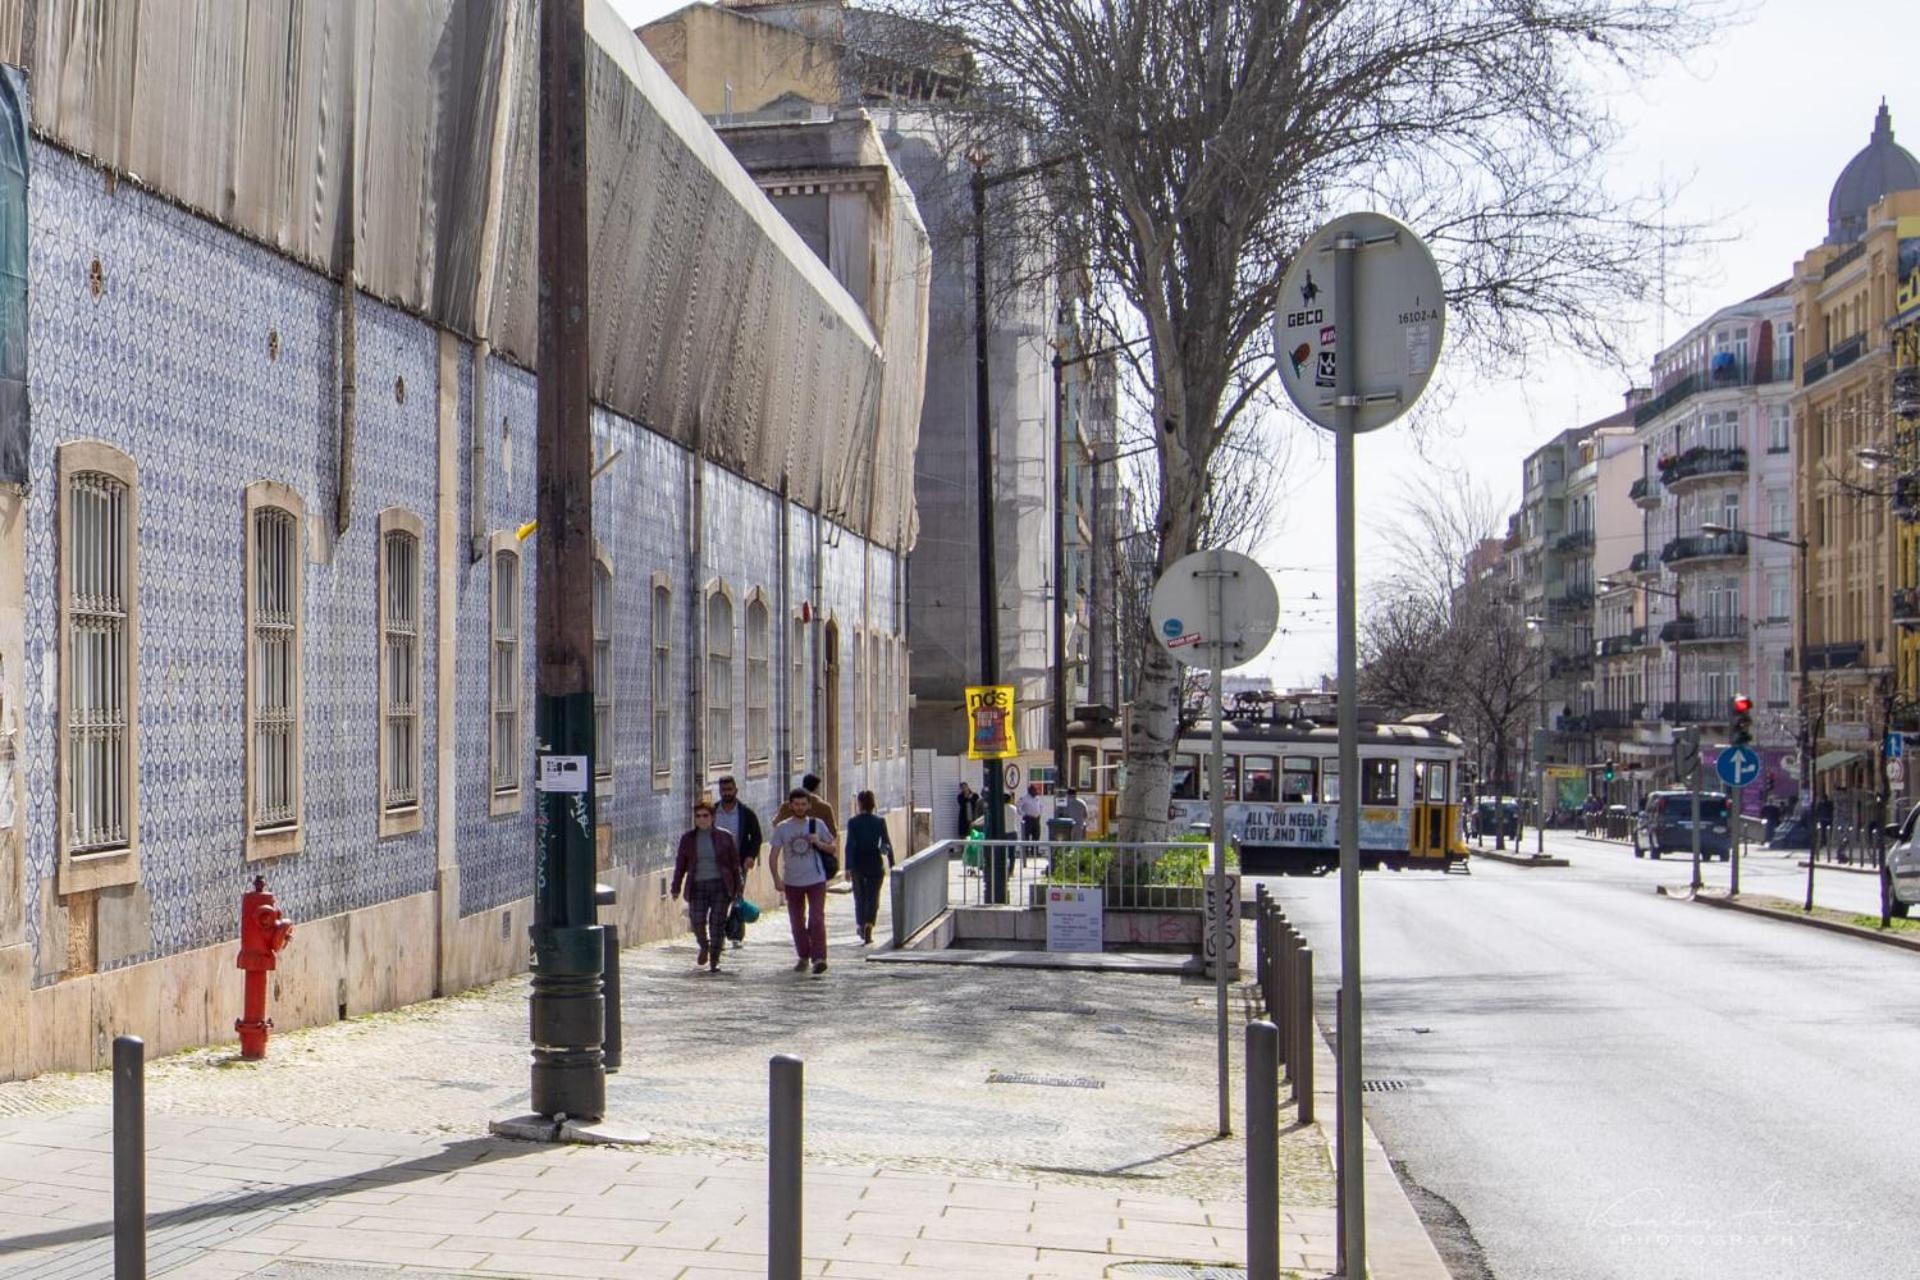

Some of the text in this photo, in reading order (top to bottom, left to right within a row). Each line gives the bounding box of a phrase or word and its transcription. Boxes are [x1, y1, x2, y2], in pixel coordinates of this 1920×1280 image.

[1398, 309, 1438, 324] 16102-A
[1246, 812, 1263, 826] ALL
[1266, 812, 1286, 827] YOU
[1289, 813, 1315, 827] NEED
[1244, 827, 1324, 843] LOVE AND TIME
